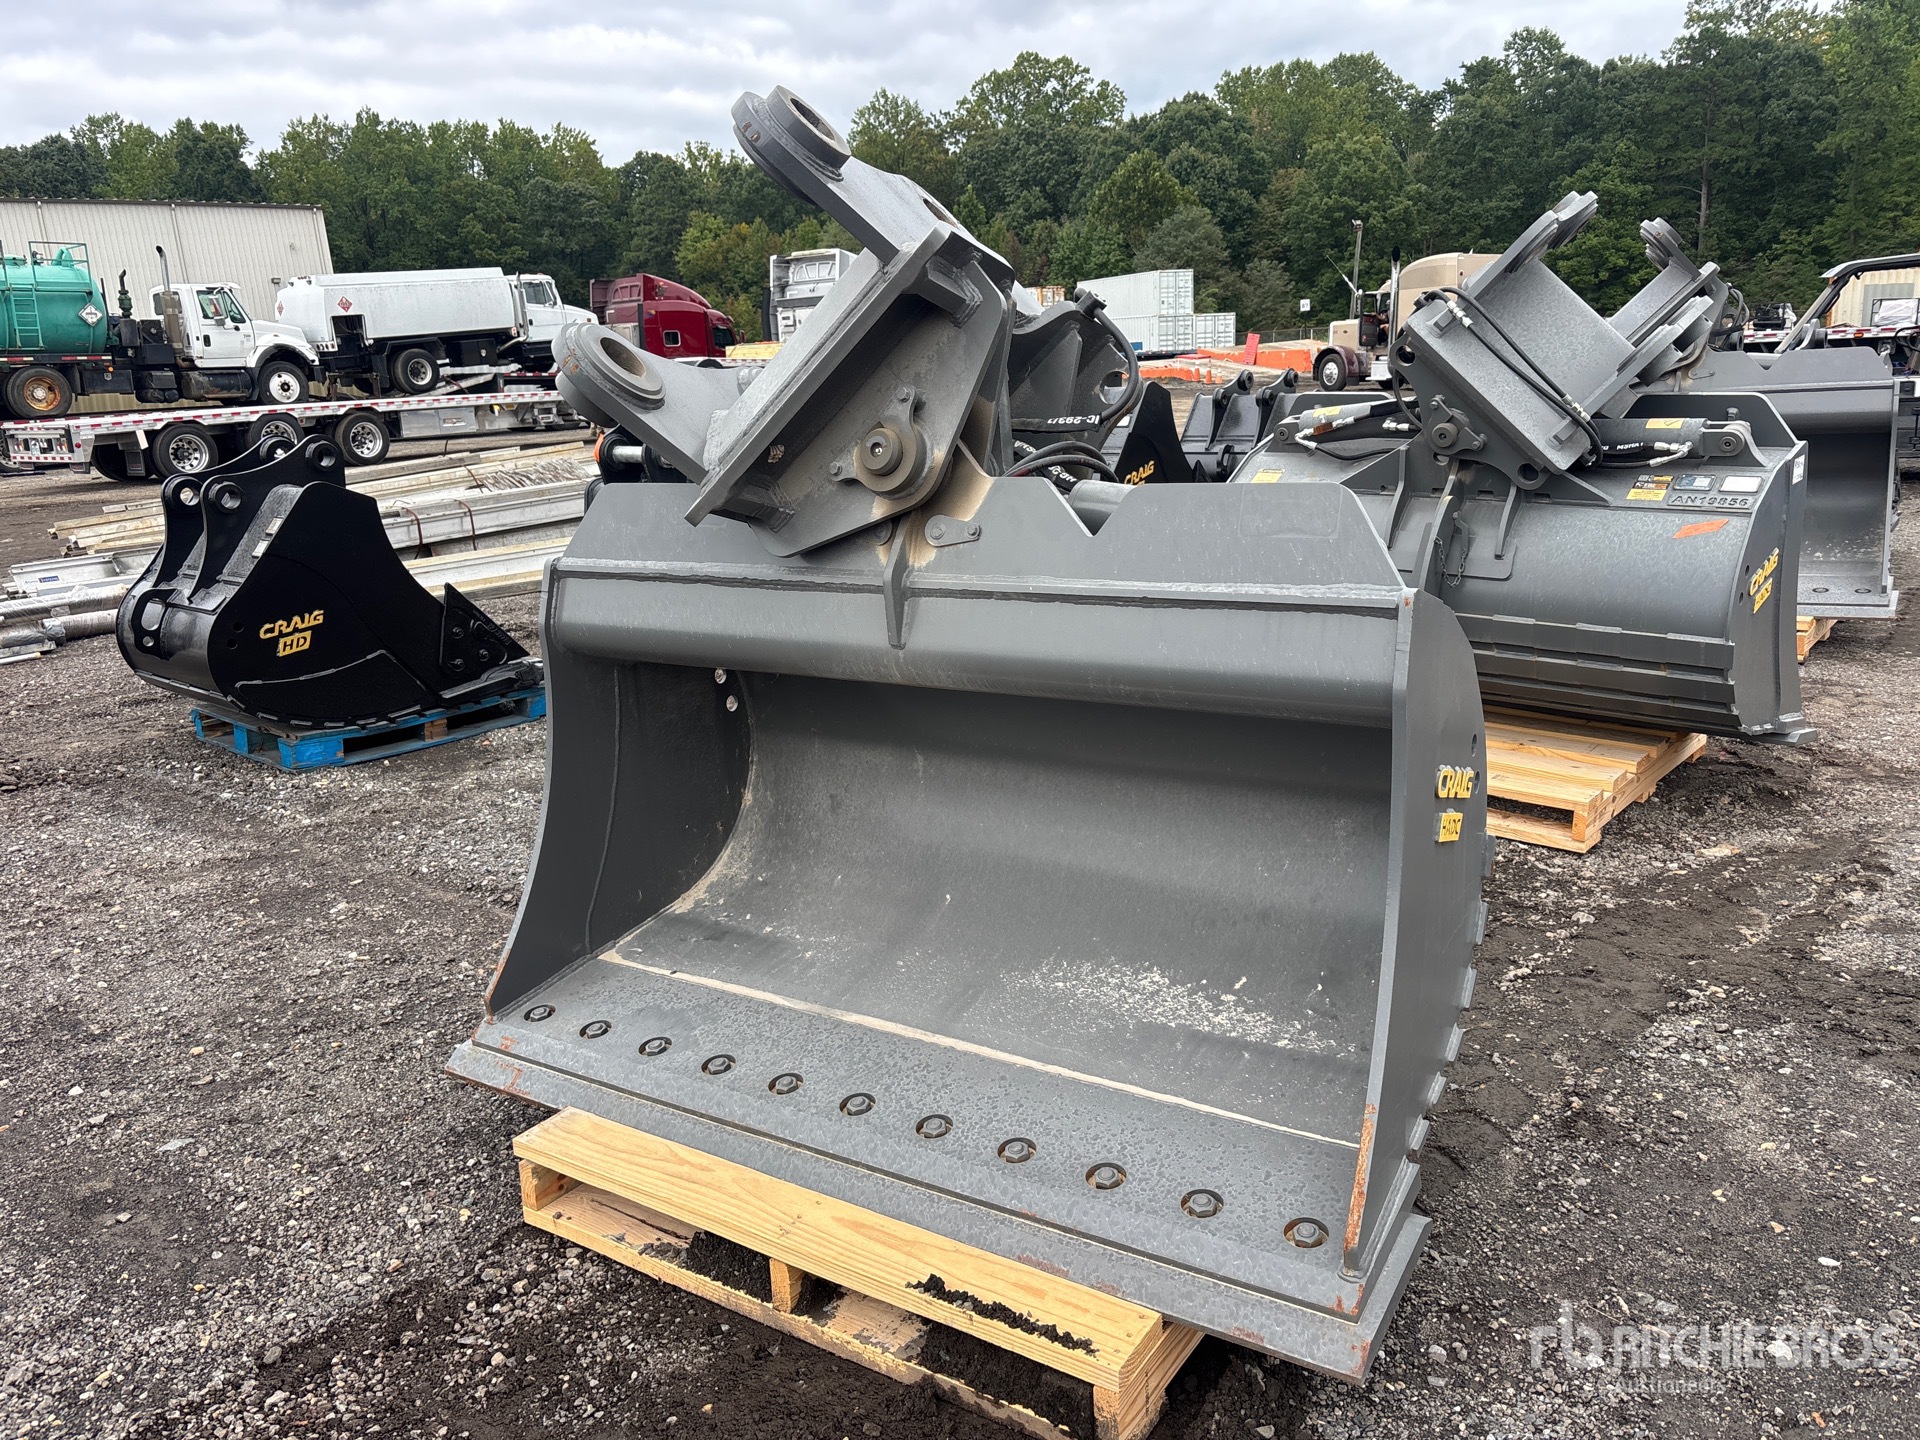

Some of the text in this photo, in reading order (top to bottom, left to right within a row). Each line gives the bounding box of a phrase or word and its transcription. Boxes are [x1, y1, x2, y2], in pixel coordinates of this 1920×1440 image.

[1124, 460, 1155, 485] CRAIG
[1750, 547, 1779, 596] CRAIG
[259, 609, 324, 639] CRAIG
[281, 634, 309, 654] HD
[1437, 766, 1474, 798] CRAIG
